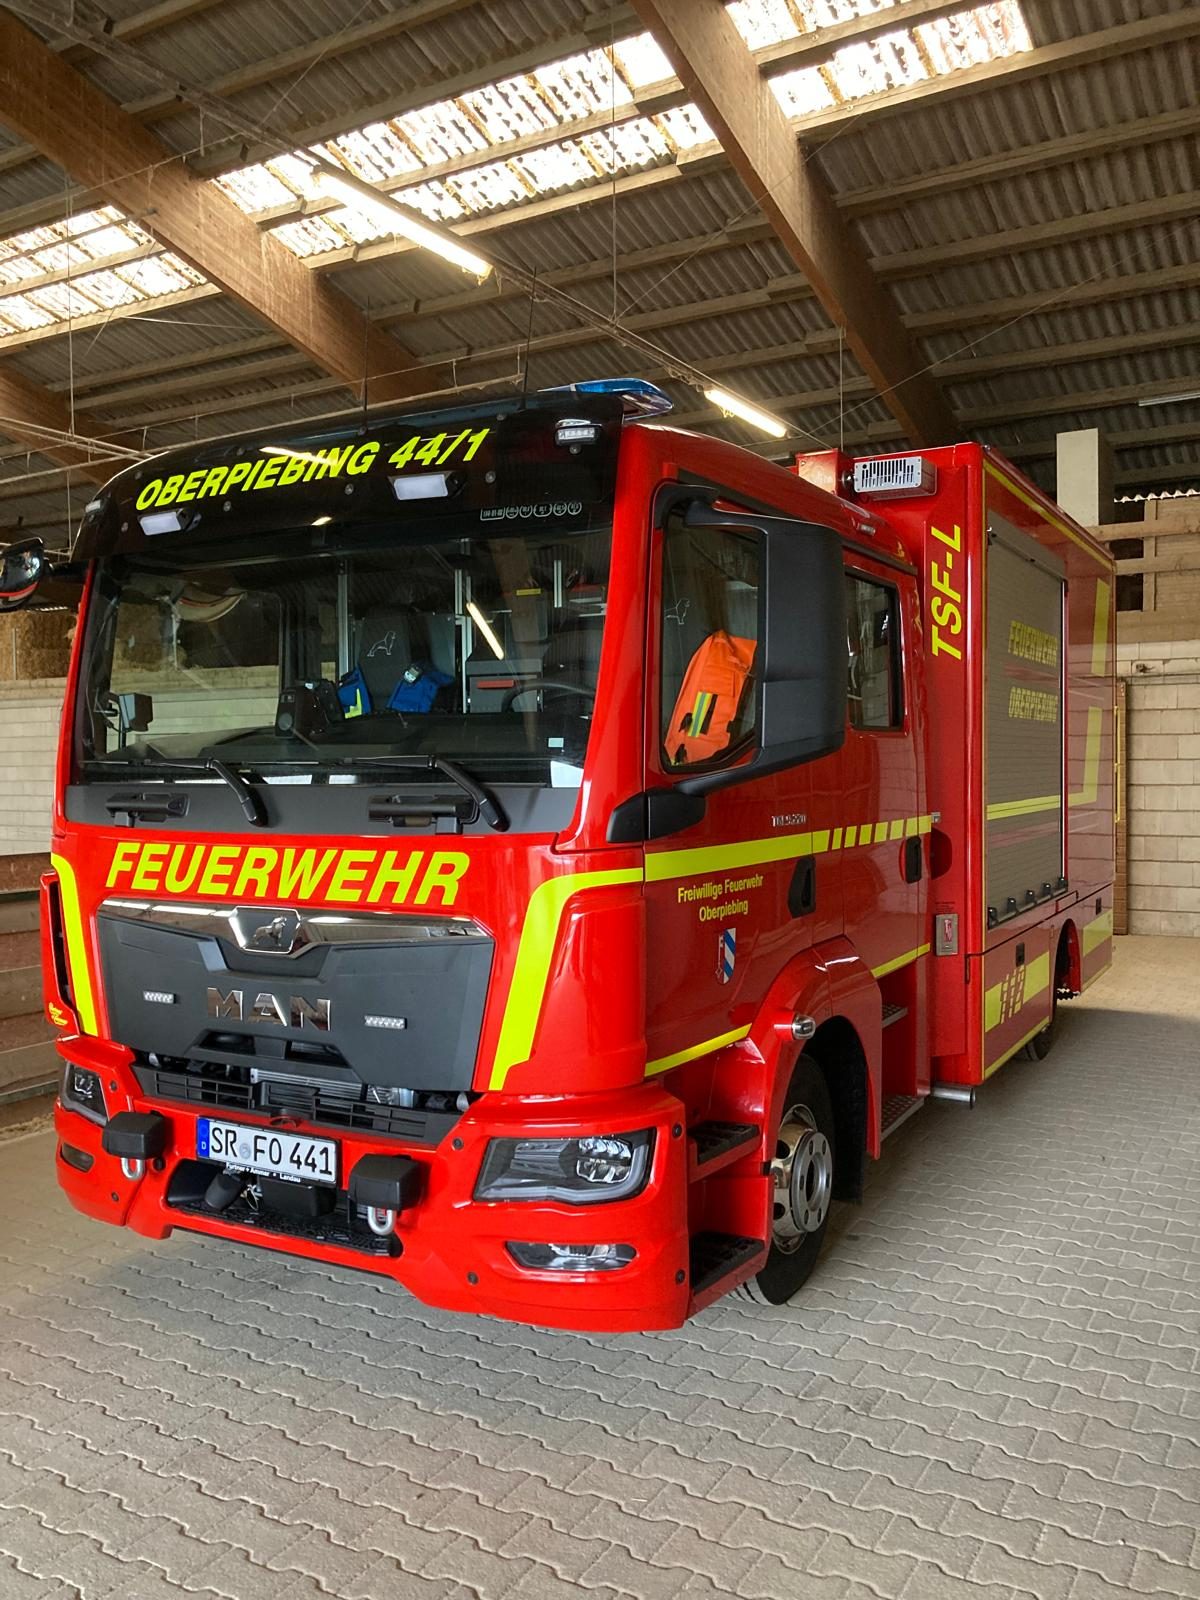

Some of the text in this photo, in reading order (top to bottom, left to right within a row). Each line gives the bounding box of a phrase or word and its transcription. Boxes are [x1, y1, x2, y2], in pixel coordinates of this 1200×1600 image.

[135, 428, 490, 511] OBERPIEBING 44/1
[931, 524, 962, 660] TSF-L
[1008, 619, 1058, 668] FEUERWEHR
[105, 842, 471, 906] FEUERWEHR
[677, 873, 764, 904] Freiwillige Feuerwehr
[699, 898, 749, 922] Oberpiebing
[207, 986, 332, 1031] MAN
[201, 1141, 207, 1150] D
[211, 1127, 333, 1176] SR FO 441
[279, 1173, 301, 1183] Landau
